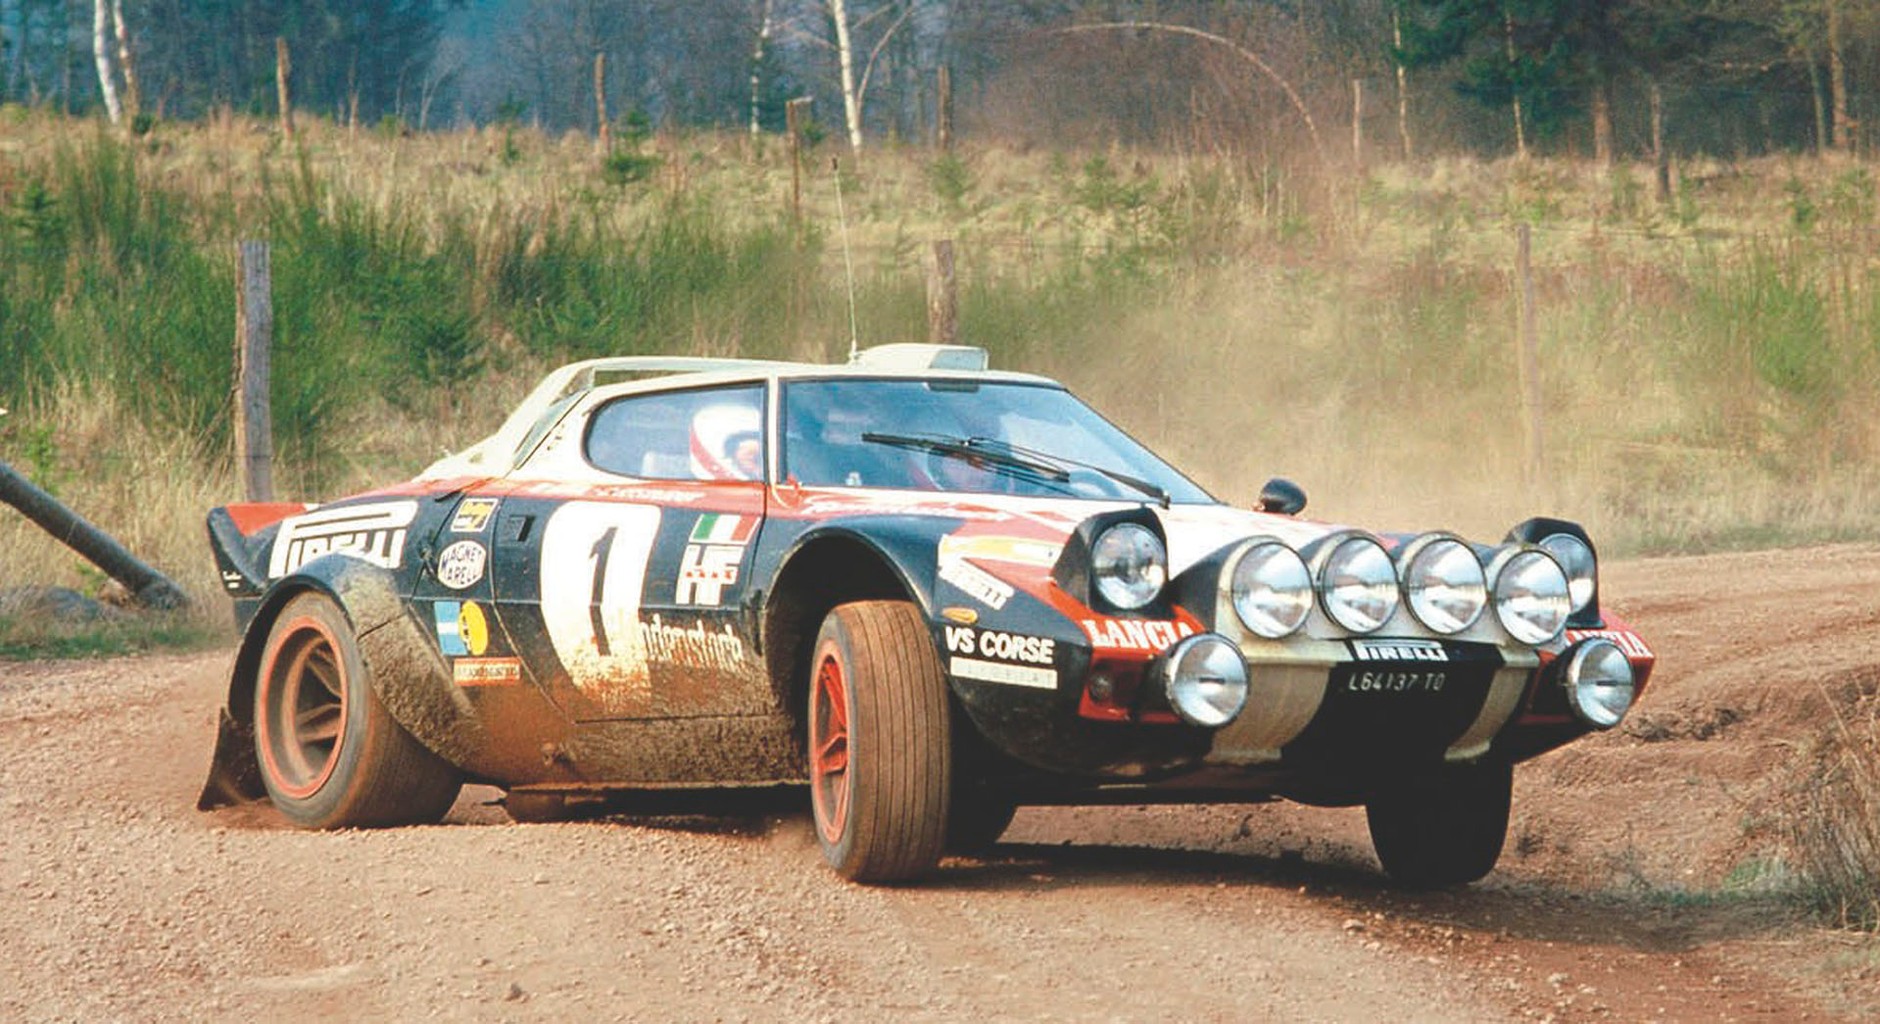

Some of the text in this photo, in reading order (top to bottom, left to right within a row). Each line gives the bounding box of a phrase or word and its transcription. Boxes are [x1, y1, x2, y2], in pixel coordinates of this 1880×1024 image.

[268, 501, 419, 579] PIRELLI
[589, 526, 618, 657] 1
[675, 545, 745, 606] HF
[945, 627, 1056, 664] VS CORSE
[1082, 619, 1194, 650] LANCIA
[1351, 640, 1450, 661] PIRELLI
